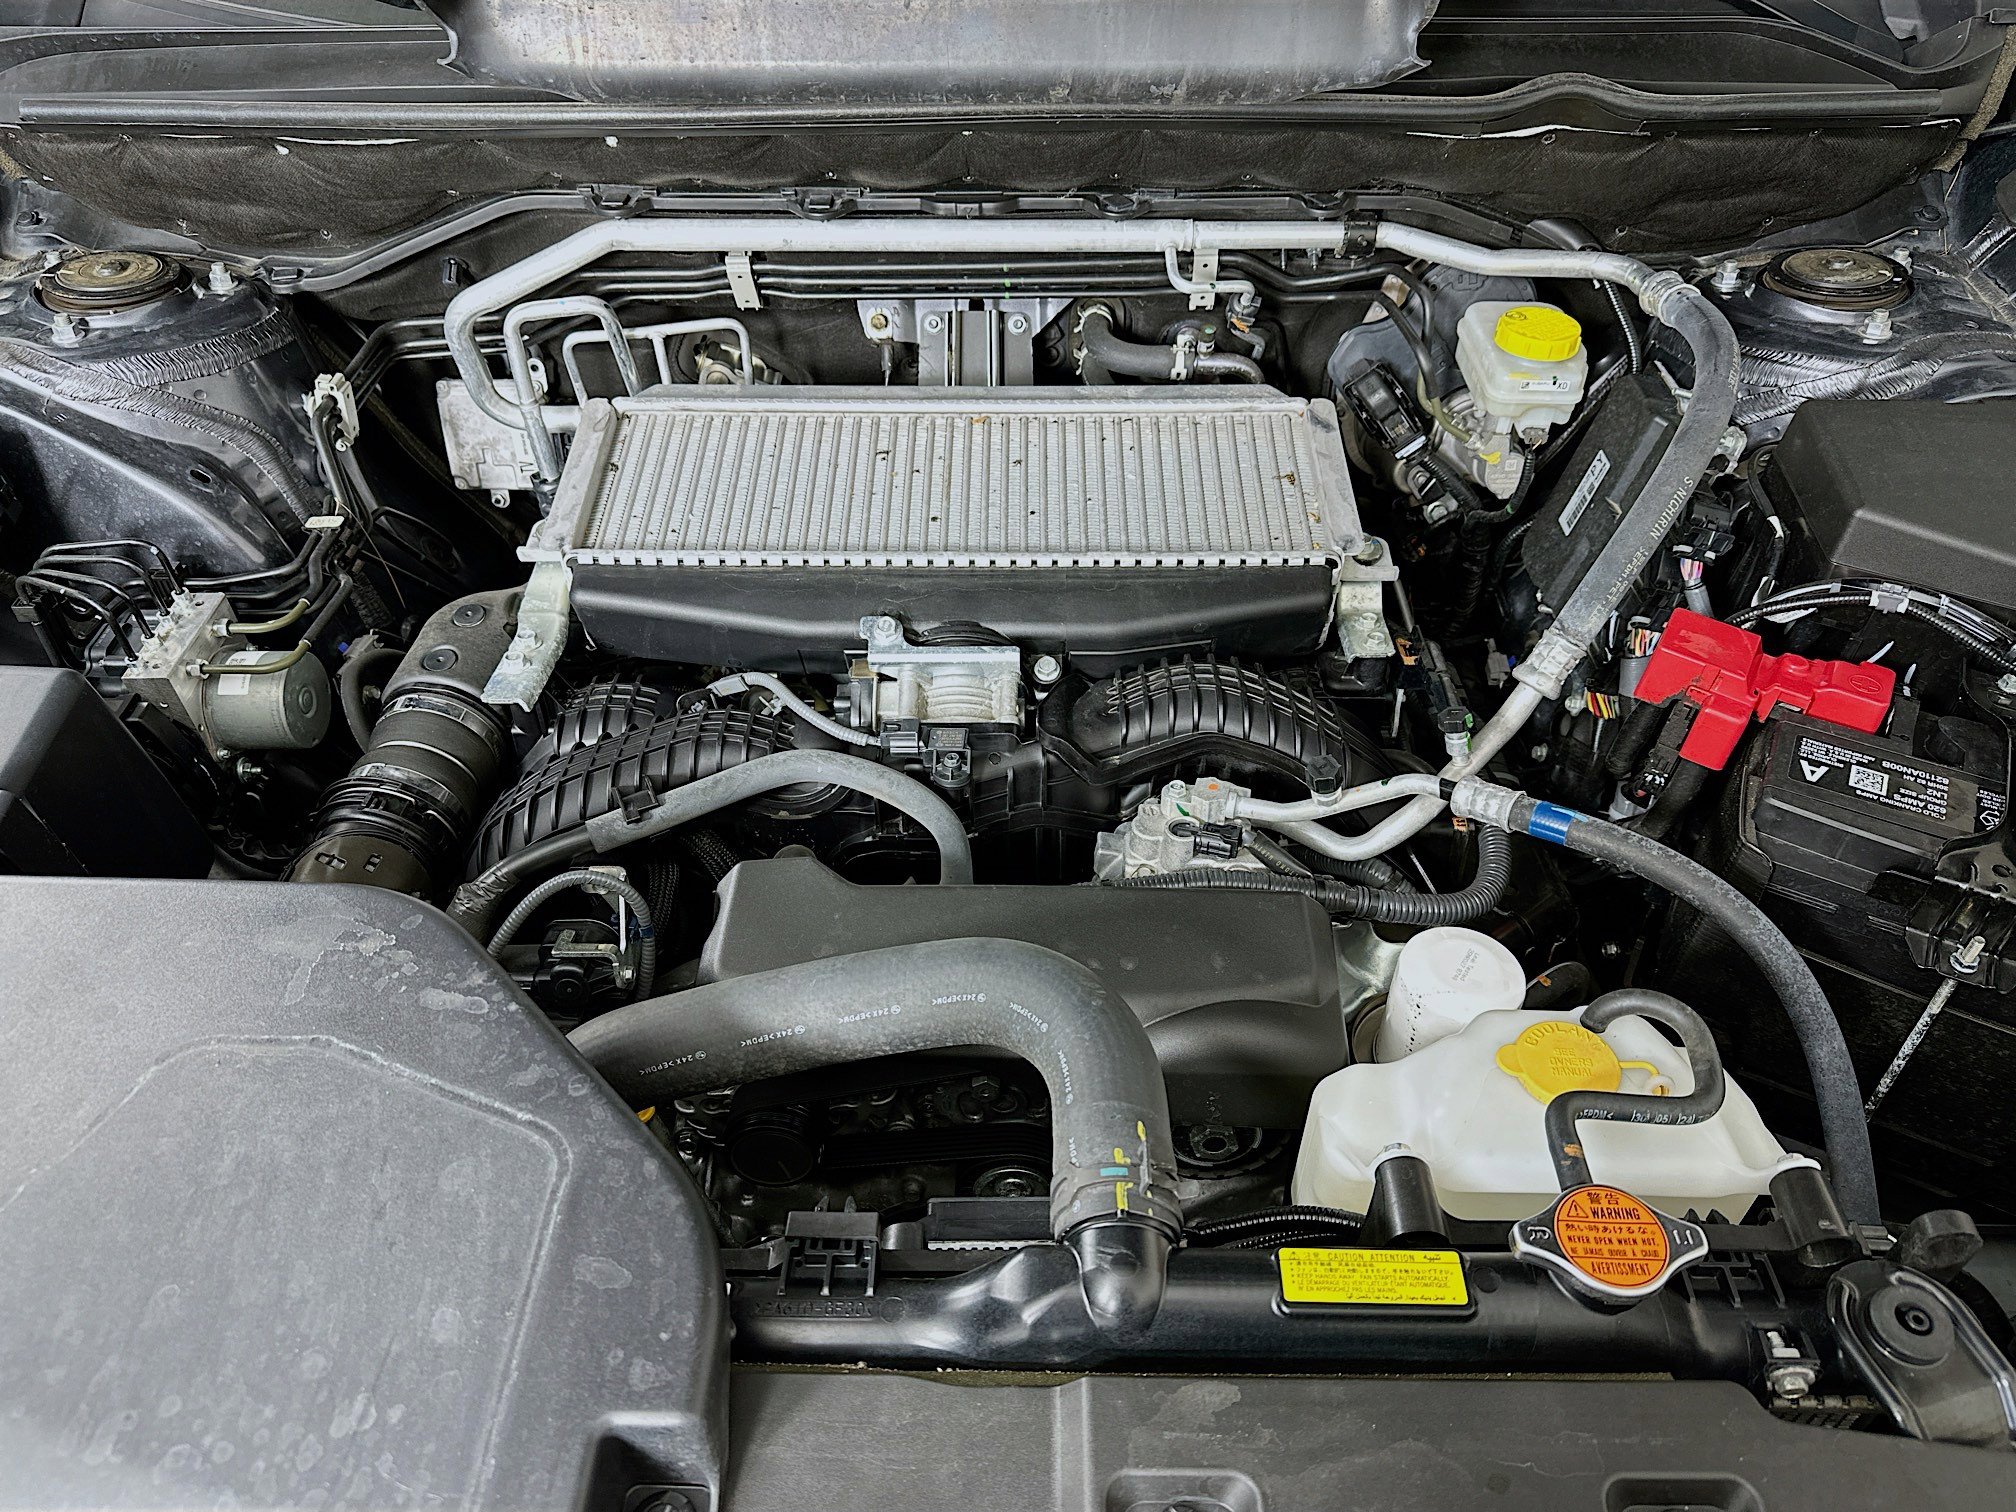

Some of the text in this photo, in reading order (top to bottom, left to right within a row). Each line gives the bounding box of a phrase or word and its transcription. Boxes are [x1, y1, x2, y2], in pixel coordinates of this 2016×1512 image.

[1800, 760, 1830, 782] A
[1900, 788, 1948, 806] GROUP SIZE
[1926, 788, 1948, 800] LN2
[1856, 790, 1946, 820] COLD CRANKING AMPS
[1894, 794, 1946, 814] 620 AMPS
[1586, 1192, 1620, 1205] 警告
[1590, 1206, 1640, 1220] WARNING
[1568, 1236, 1660, 1247] NEVER OPEN WHEN HOT.
[1328, 1252, 1364, 1260] CAUTION
[1370, 1254, 1414, 1262] ATTENTION
[1584, 1248, 1603, 1256] JAMAIS
[1591, 1261, 1651, 1276] AVERTISSMENT
